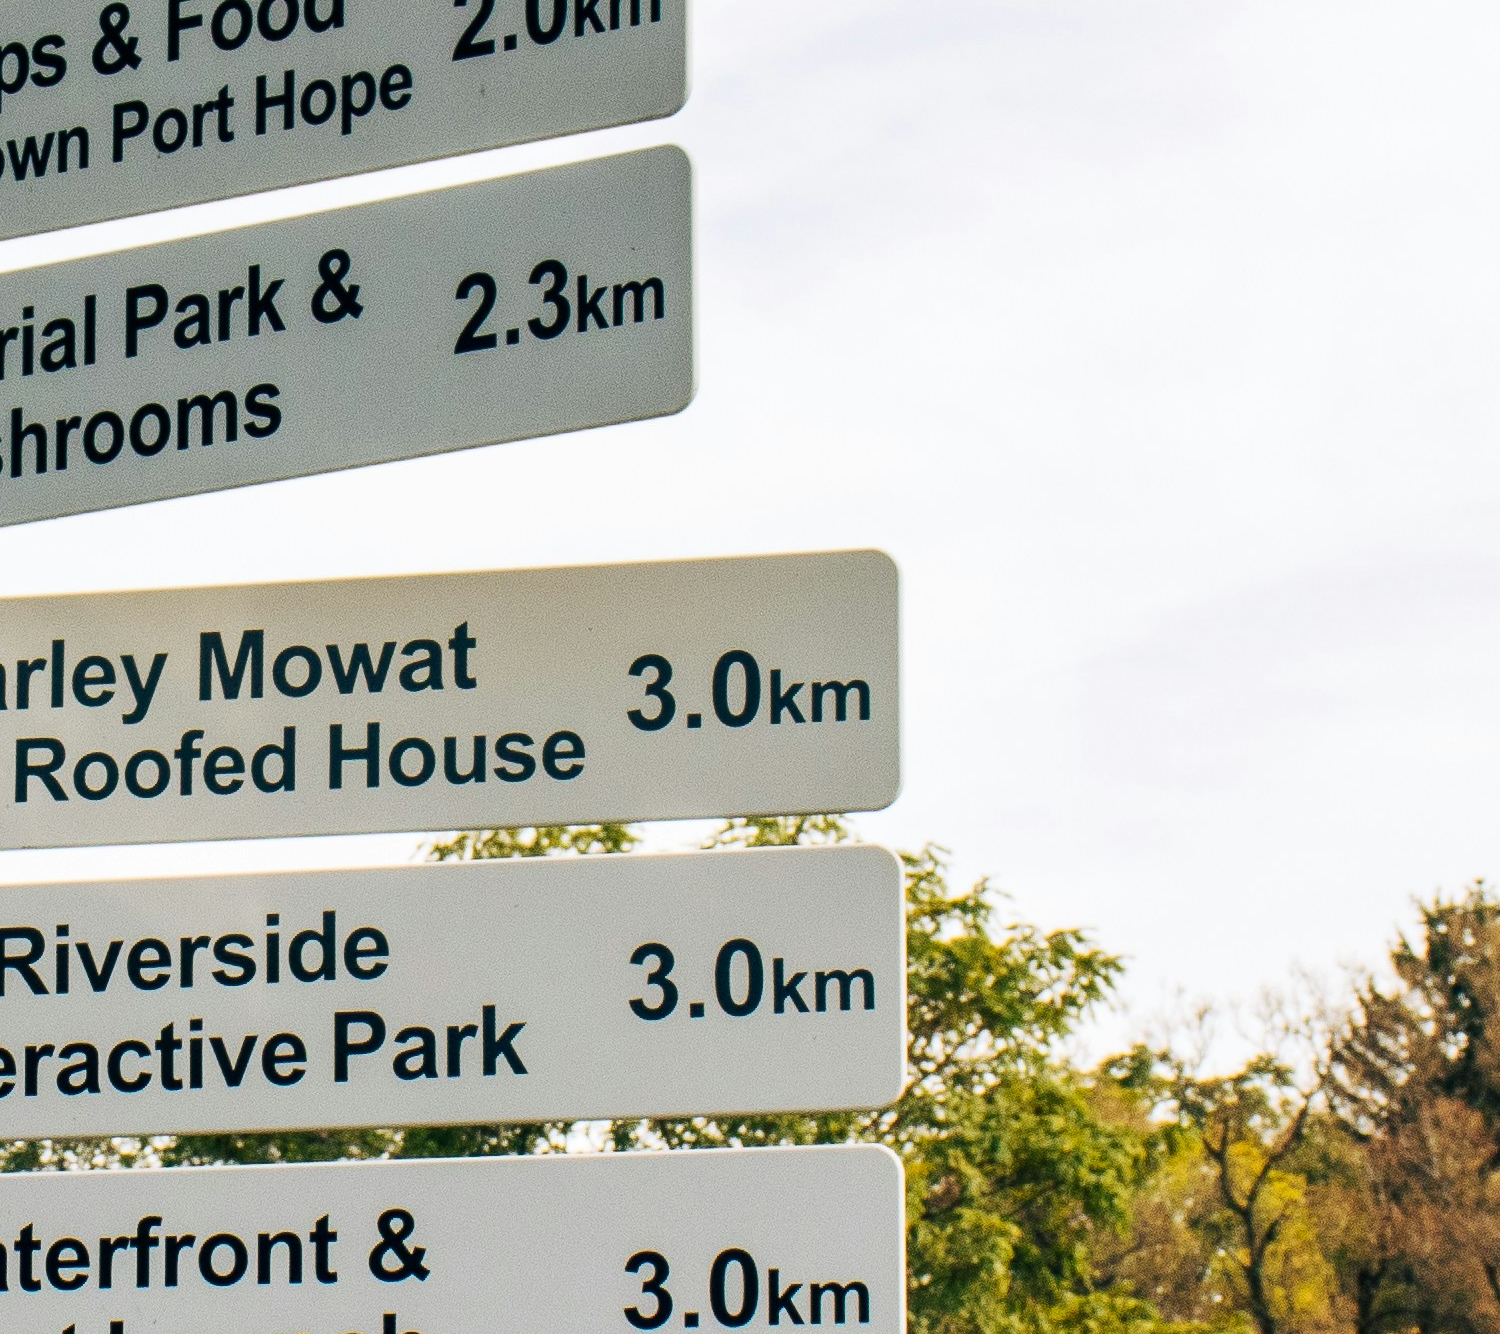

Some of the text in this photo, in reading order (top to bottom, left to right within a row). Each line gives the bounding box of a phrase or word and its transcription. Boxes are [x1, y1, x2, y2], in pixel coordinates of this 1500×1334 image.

[90, 0, 144, 77] &
[110, 82, 236, 165] Port
[253, 62, 415, 138] Hope
[123, 262, 288, 360] Park
[309, 247, 366, 326] &
[197, 619, 479, 702] Mowat
[13, 724, 297, 805] Roofed
[327, 720, 587, 791] House
[332, 1003, 530, 1084] Park
[367, 1207, 432, 1284] &
